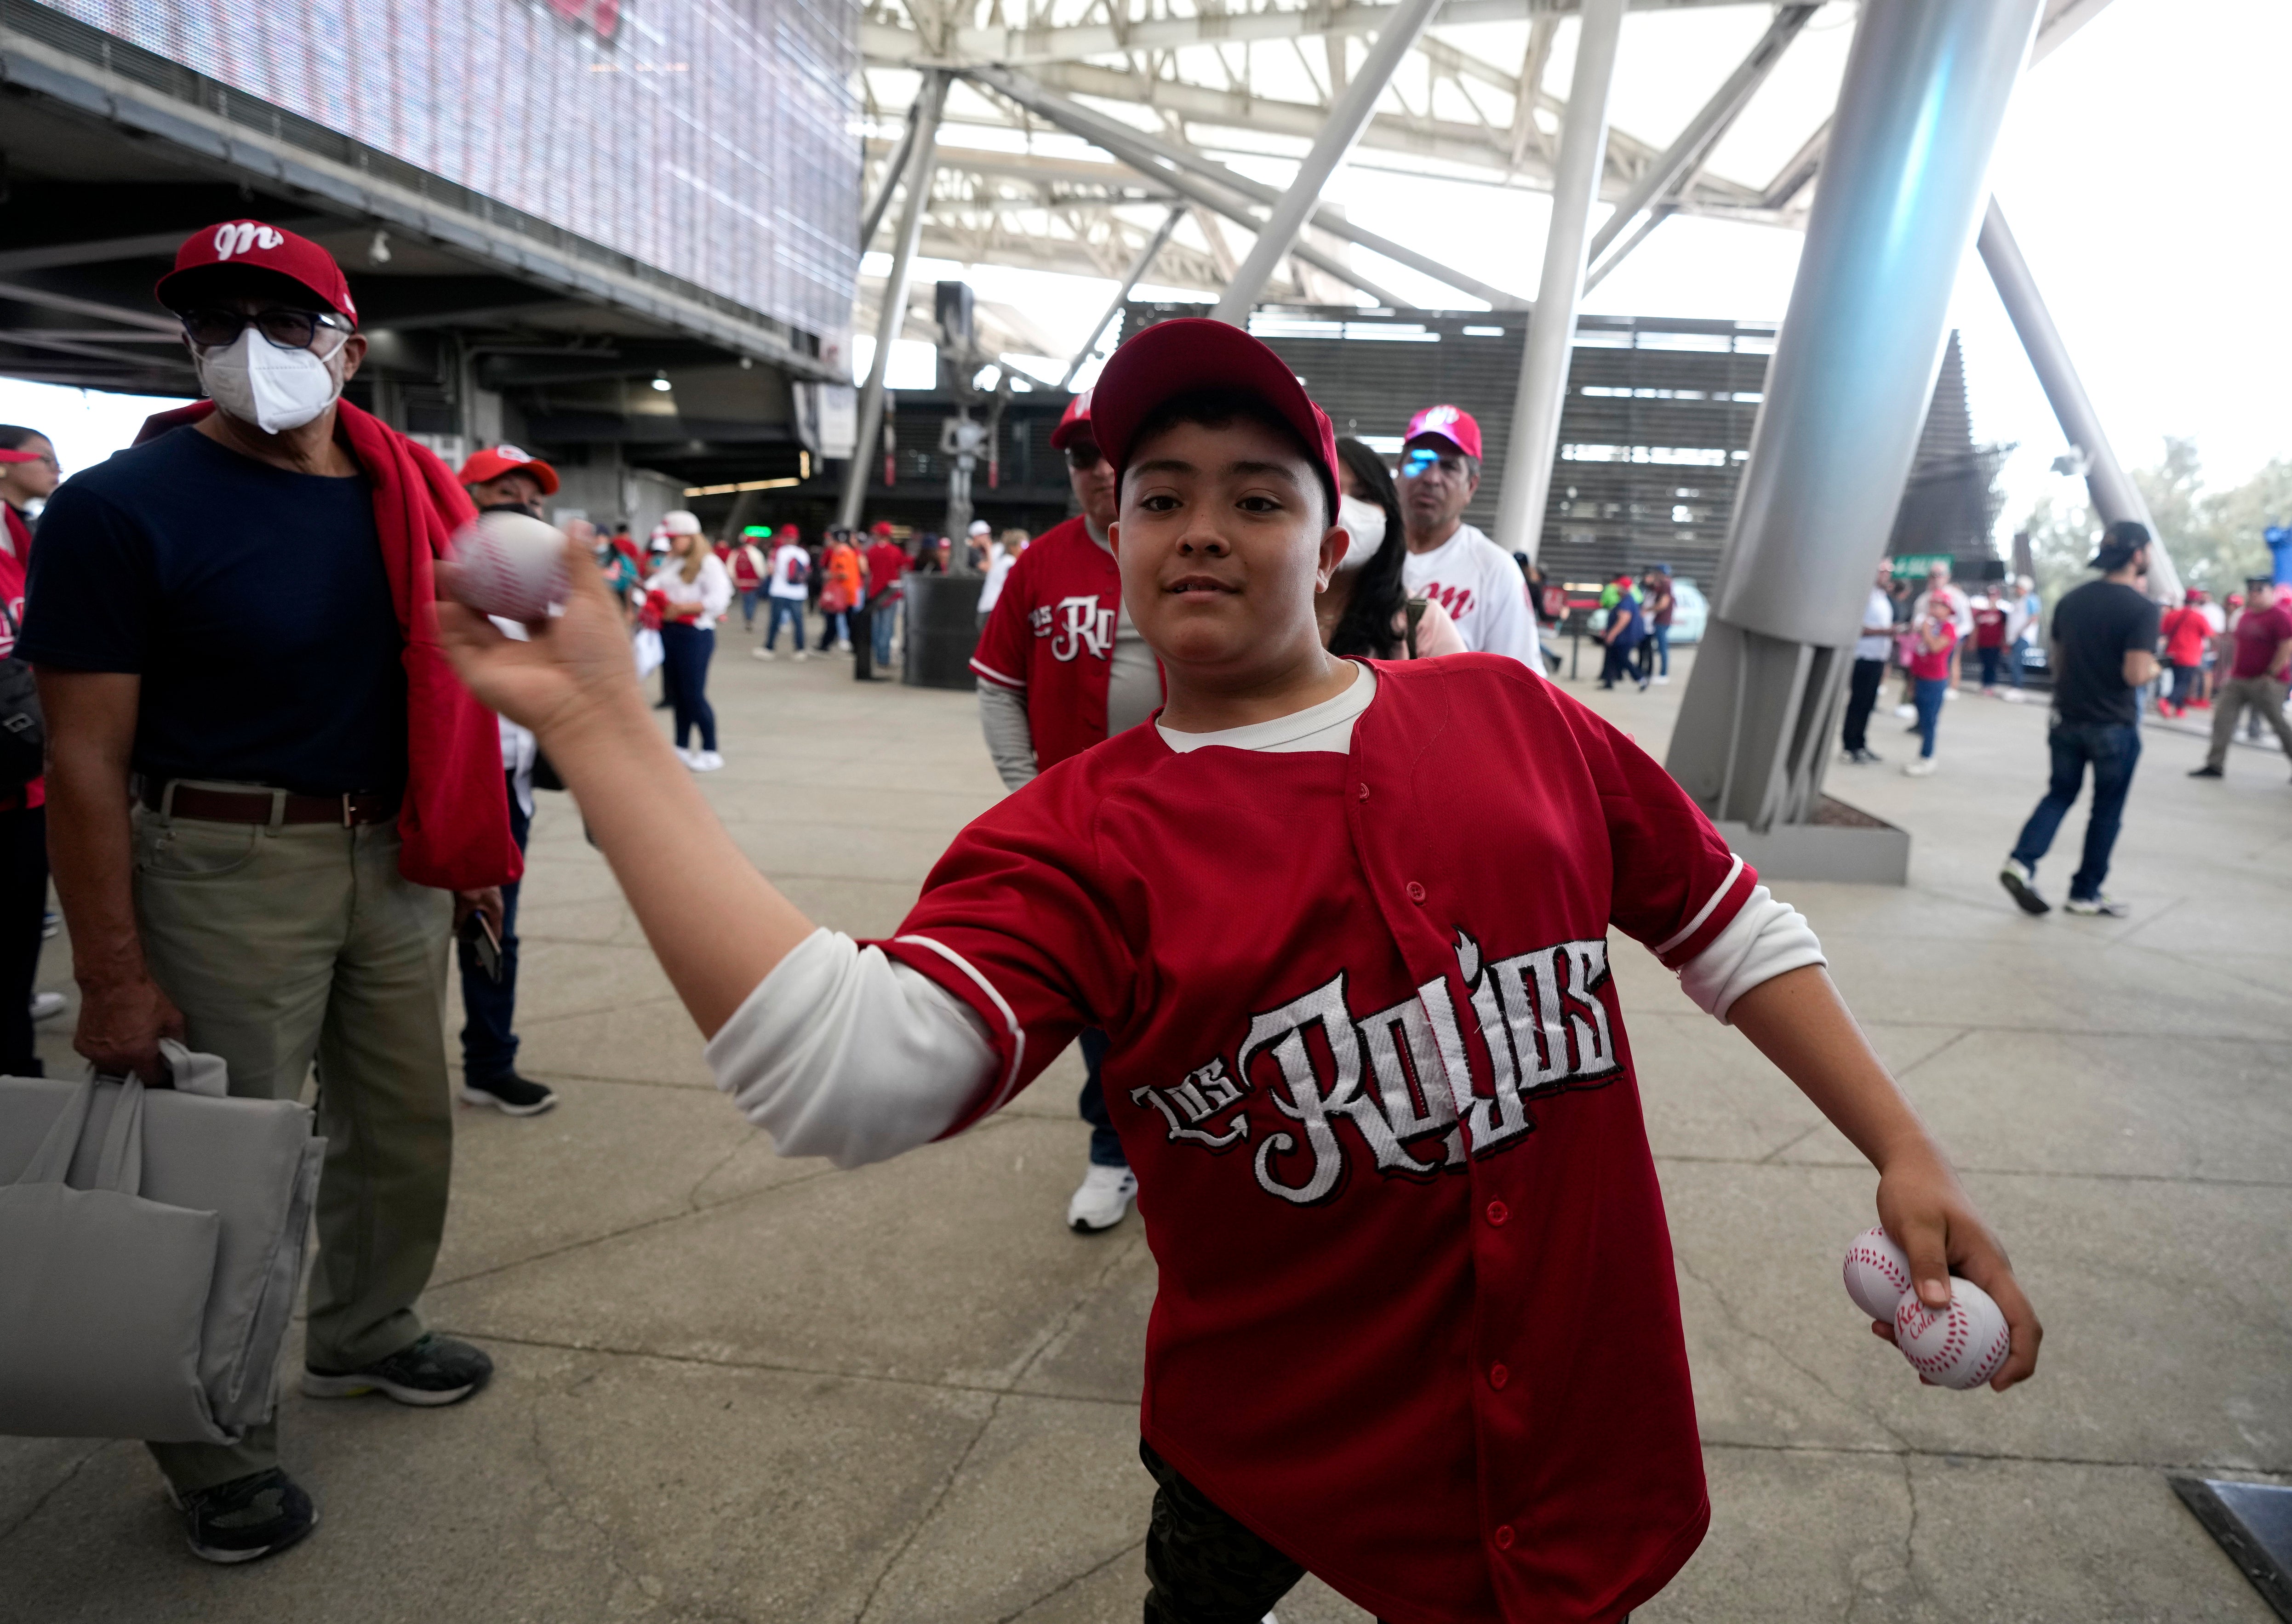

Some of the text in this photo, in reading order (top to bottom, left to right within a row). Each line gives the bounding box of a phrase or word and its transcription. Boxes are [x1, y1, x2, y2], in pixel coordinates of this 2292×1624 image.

[1129, 924, 1625, 1207] Los Rojos
[1909, 1313, 1936, 1340] Cola
